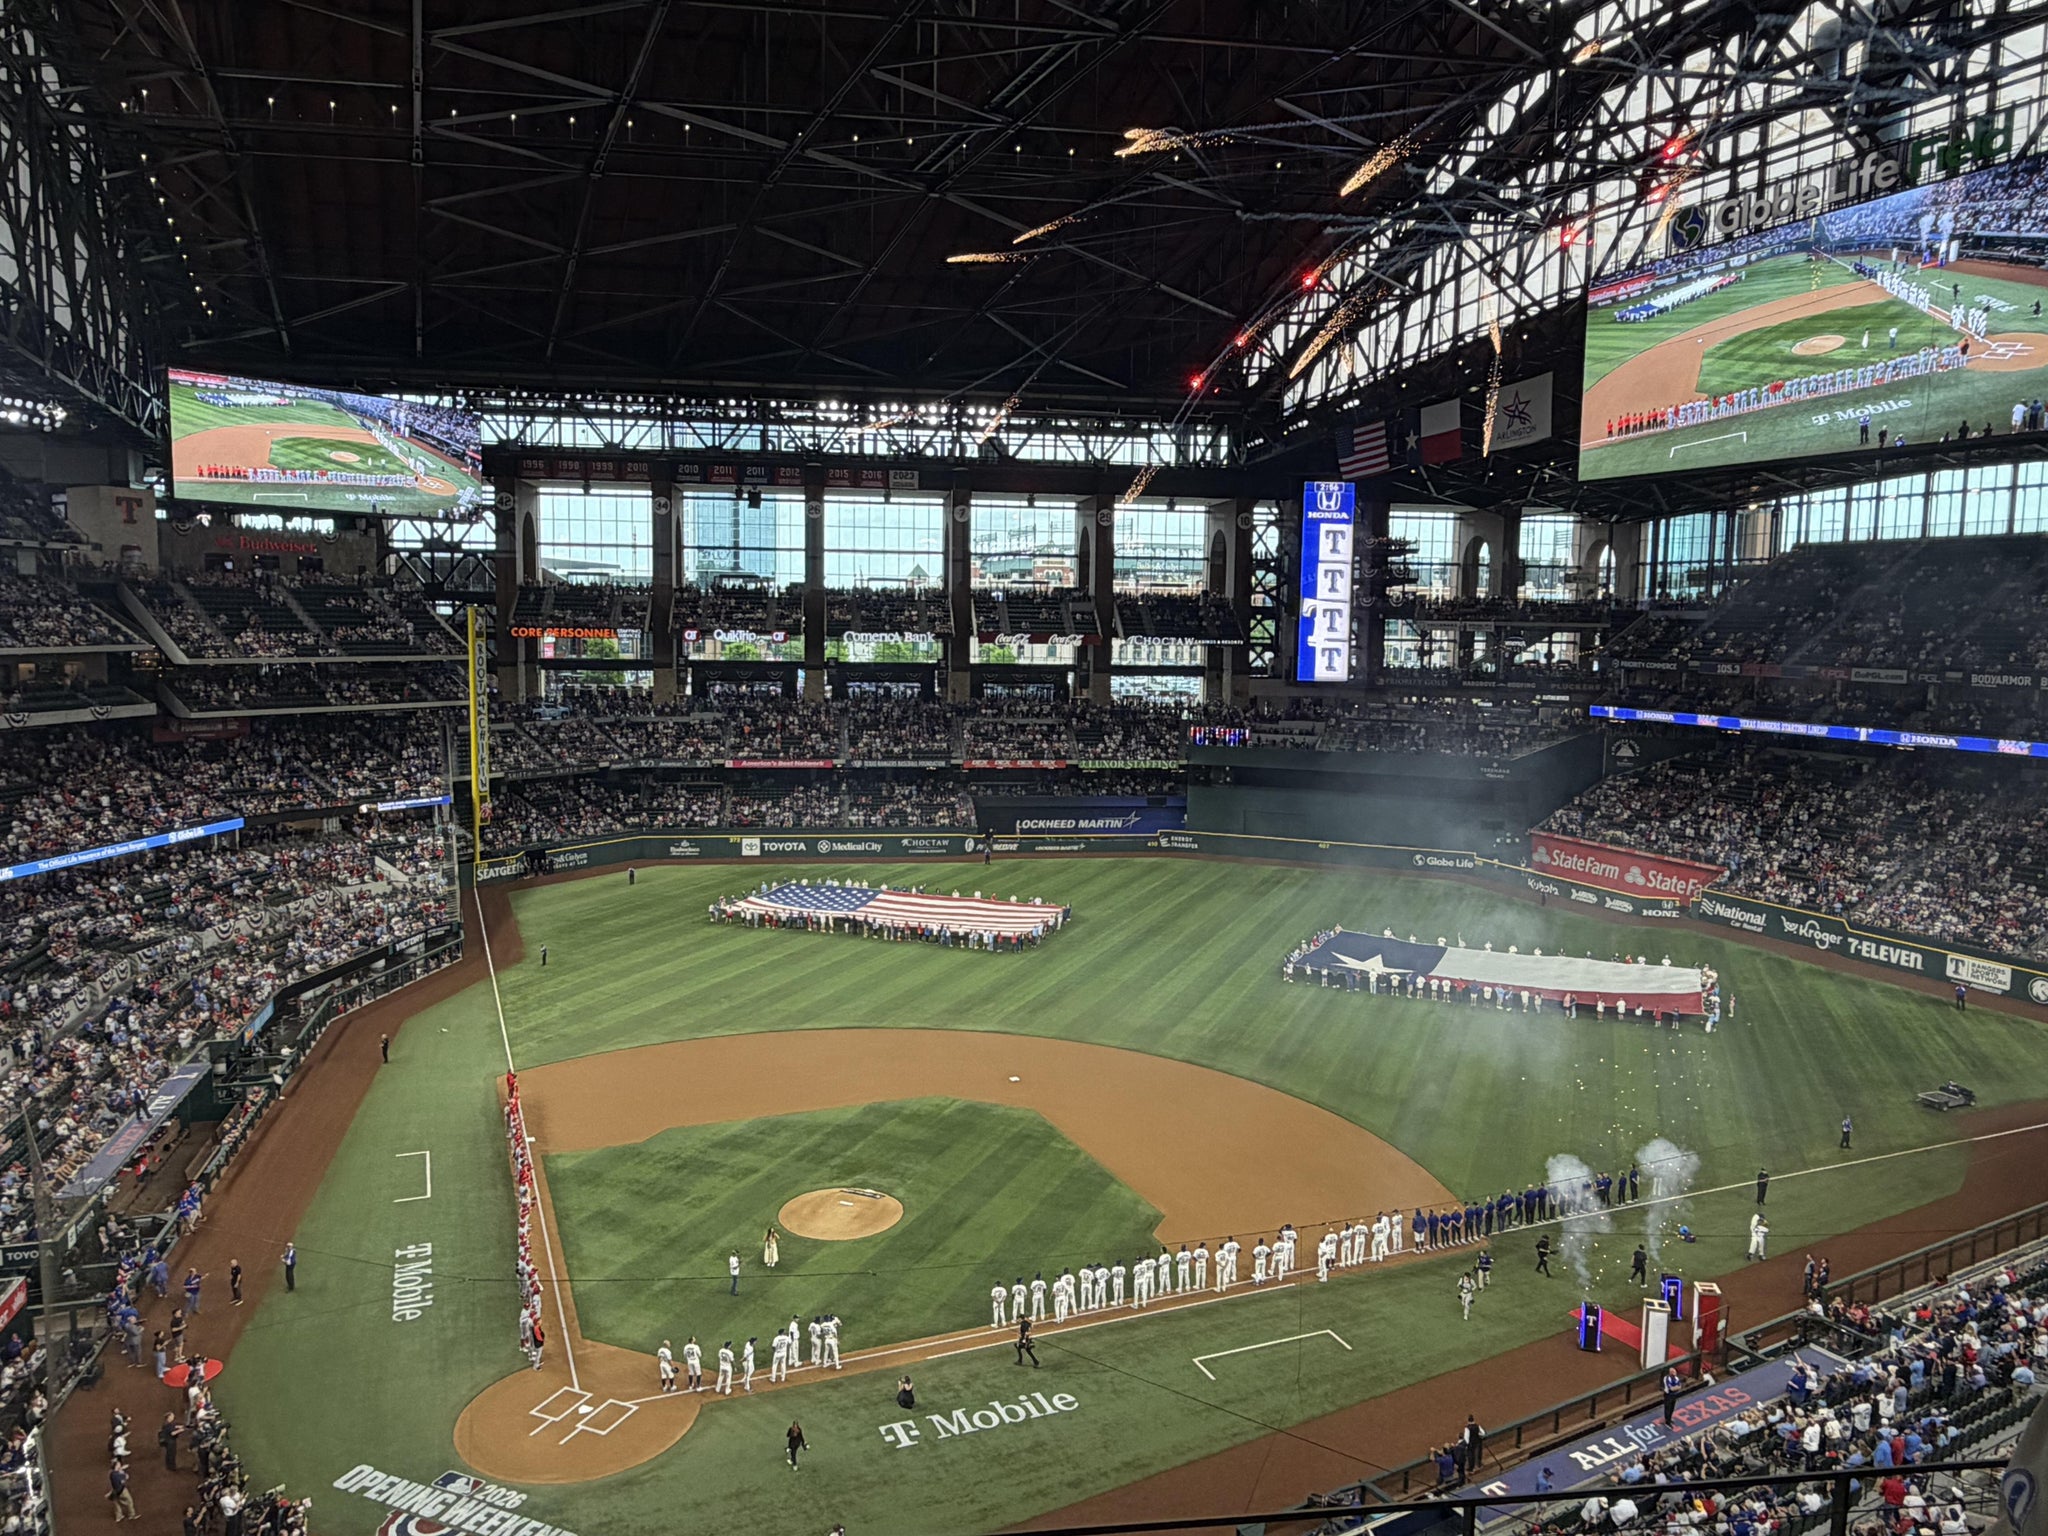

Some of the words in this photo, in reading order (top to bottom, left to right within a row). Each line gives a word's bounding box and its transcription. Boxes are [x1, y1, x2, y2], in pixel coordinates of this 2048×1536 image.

[1715, 182, 1820, 235] Globe
[1828, 152, 1899, 201] Life
[1909, 111, 2014, 180] Field
[1834, 399, 1913, 422] Mobile
[1496, 424, 1537, 441] ARLINGTON
[627, 462, 649, 472] 2010
[678, 464, 699, 474] 2010
[713, 465, 733, 475] 2011
[746, 466, 766, 476] 2011
[861, 470, 882, 480] 2016
[115, 496, 143, 524] T
[656, 501, 668, 511] 34
[808, 504, 821, 515] 26
[958, 508, 966, 518] 7
[1099, 512, 1112, 523] 29
[1307, 511, 1350, 520] HONDA
[1240, 516, 1250, 526] 10
[240, 536, 317, 553] Budweiser
[1325, 529, 1346, 554] T
[1323, 569, 1344, 593] T
[1322, 608, 1343, 633] T
[511, 627, 543, 638] CORE
[546, 627, 618, 639] PERSONNEL
[713, 628, 757, 642] QuikTrip
[903, 631, 936, 643] Bank
[994, 632, 1031, 646] Coca-Cola
[1048, 633, 1085, 647] Coca-Cola
[1131, 635, 1195, 646] CHOCTAW
[1321, 647, 1342, 672] T
[1620, 660, 1645, 669] PRIORITY
[1645, 661, 1677, 671] COMMERCE
[1716, 664, 1741, 674] 105.3
[1826, 670, 1849, 679] PGL
[1385, 678, 1423, 686] PRIORITY
[1424, 678, 1448, 687] GOLD
[1854, 671, 1905, 682] GoPGL.com
[1918, 674, 1941, 683] PGL
[1971, 673, 2032, 687] BODYARMOR
[1462, 680, 1496, 688] HARGROVE
[1551, 683, 1601, 691] PLUCKERS
[1643, 711, 1675, 722] HONDA
[1781, 722, 1807, 734] STARTING
[1807, 724, 1829, 736] LINEUP
[1910, 735, 1958, 748] HONDA
[877, 760, 897, 768] RANGERS
[1125, 760, 1177, 769] STAFFING
[1016, 819, 1076, 829] LOCKHEED
[1078, 818, 1123, 829] MARTIN
[177, 829, 193, 840] Globe
[193, 827, 205, 838] Life
[763, 842, 807, 851] TOYOTA
[832, 842, 865, 851] Medical
[865, 842, 883, 853] City
[903, 839, 950, 847] CHOCTAW
[1171, 841, 1199, 849] TRANSFER
[48, 858, 67, 868] Official
[77, 850, 101, 862] Insurance
[1426, 856, 1455, 867] Globe
[1456, 858, 1474, 869] Life
[1527, 878, 1560, 896] Kubota
[1714, 902, 1766, 926] National
[1730, 919, 1742, 927] Car
[1742, 922, 1763, 933] Rental
[1799, 919, 1844, 950] Kroger
[1950, 957, 1966, 976] T
[1970, 962, 2007, 976] RANGERS
[1970, 968, 1999, 979] SPORTS
[1970, 972, 2008, 986] NETWORK
[391, 1258, 435, 1322] Mobile
[1668, 1285, 1678, 1297] T
[1586, 1315, 1597, 1327] T
[925, 1391, 1080, 1440] Mobile
[1653, 1387, 1752, 1433] TEXAS
[1623, 1422, 1660, 1452] for
[1569, 1436, 1640, 1471] ALL
[332, 1463, 458, 1518] OPENING
[1480, 1480, 1507, 1497] T
[475, 1484, 529, 1510] 2026
